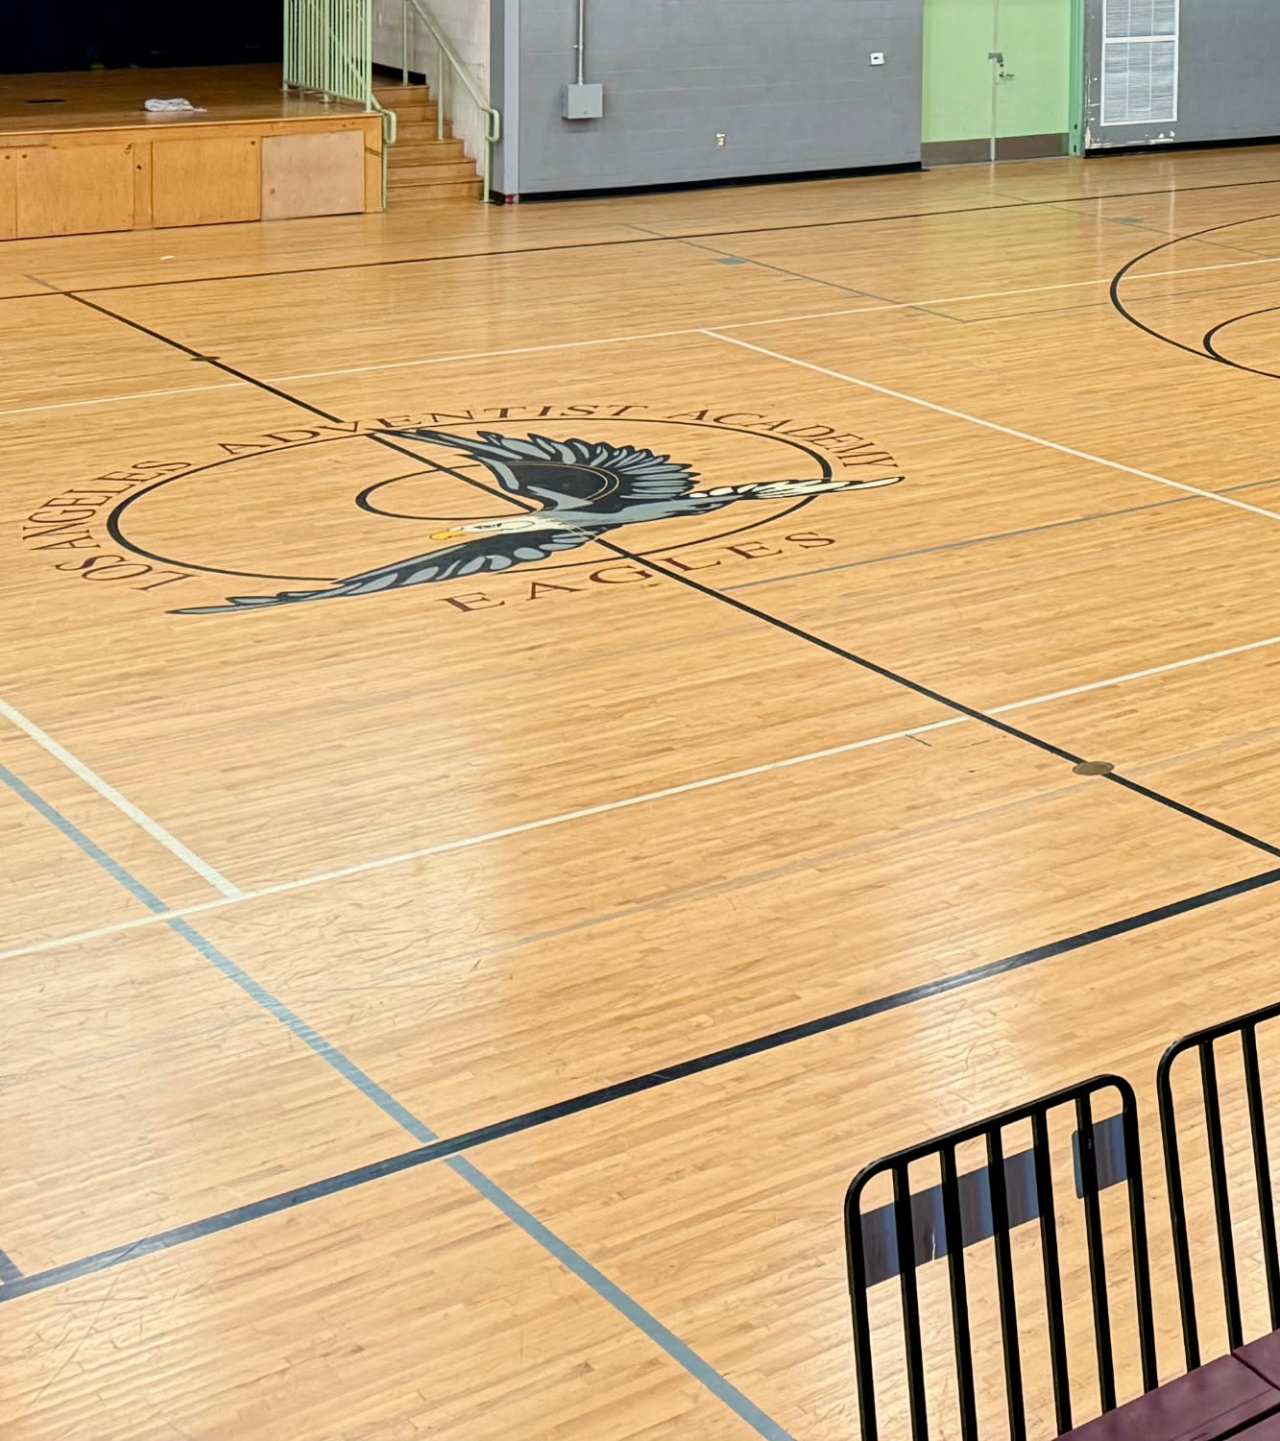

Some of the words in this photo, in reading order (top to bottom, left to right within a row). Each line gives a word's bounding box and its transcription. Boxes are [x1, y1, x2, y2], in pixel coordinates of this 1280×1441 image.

[217, 404, 649, 456] ADVENTIST
[668, 407, 899, 470] ACADEMY
[22, 460, 192, 552] ANGELES
[55, 554, 199, 591] LOS
[443, 529, 837, 613] EAGLES
